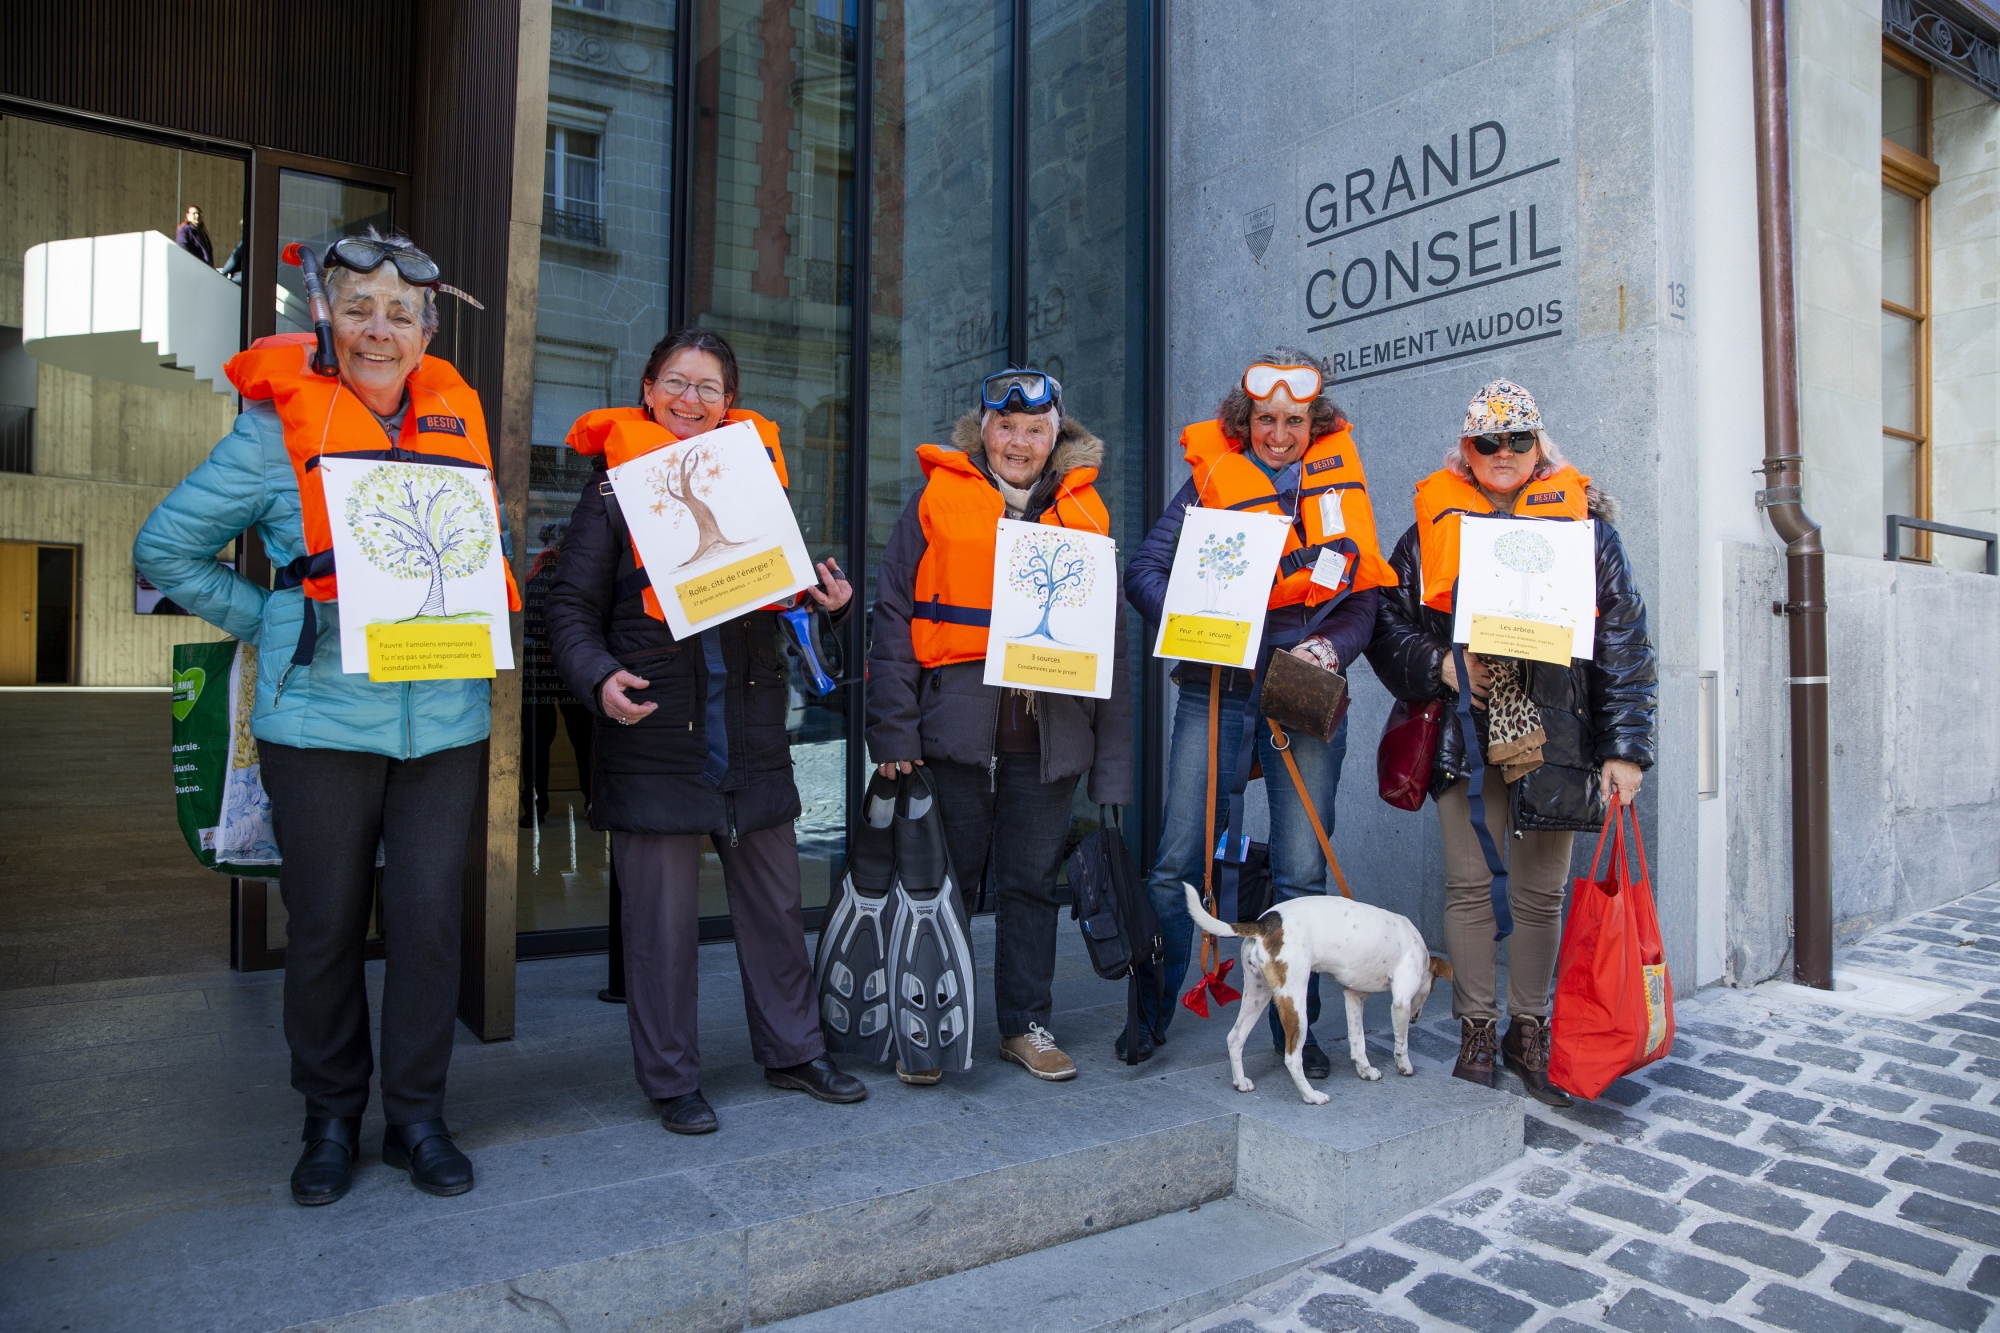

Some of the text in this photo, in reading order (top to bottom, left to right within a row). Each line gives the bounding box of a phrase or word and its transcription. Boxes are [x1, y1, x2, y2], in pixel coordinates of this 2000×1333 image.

[1305, 120, 1507, 234] GRAND
[1305, 203, 1562, 320] CONSEIL
[1668, 281, 1686, 309] 13
[1321, 299, 1563, 374] ARLEMENT VAUDOIS
[1487, 396, 1513, 422] NY
[426, 416, 457, 430] BESTO
[1312, 457, 1335, 471] BESTO
[1534, 493, 1557, 502] BESTO
[688, 585, 711, 597] Rolle,
[710, 577, 726, 589] cité
[726, 574, 736, 583] de
[714, 589, 730, 599] arbres
[1178, 627, 1233, 640] Peur et sécurité
[1500, 623, 1535, 635] Les arbres
[437, 640, 473, 648] emprisonné
[406, 654, 417, 662] pas
[433, 652, 470, 661] responsable
[1031, 653, 1061, 664] 3 sources
[381, 664, 421, 672] inondations
[541, 668, 551, 676] AU
[1062, 669, 1077, 677] projet
[177, 679, 195, 691] ANNI
